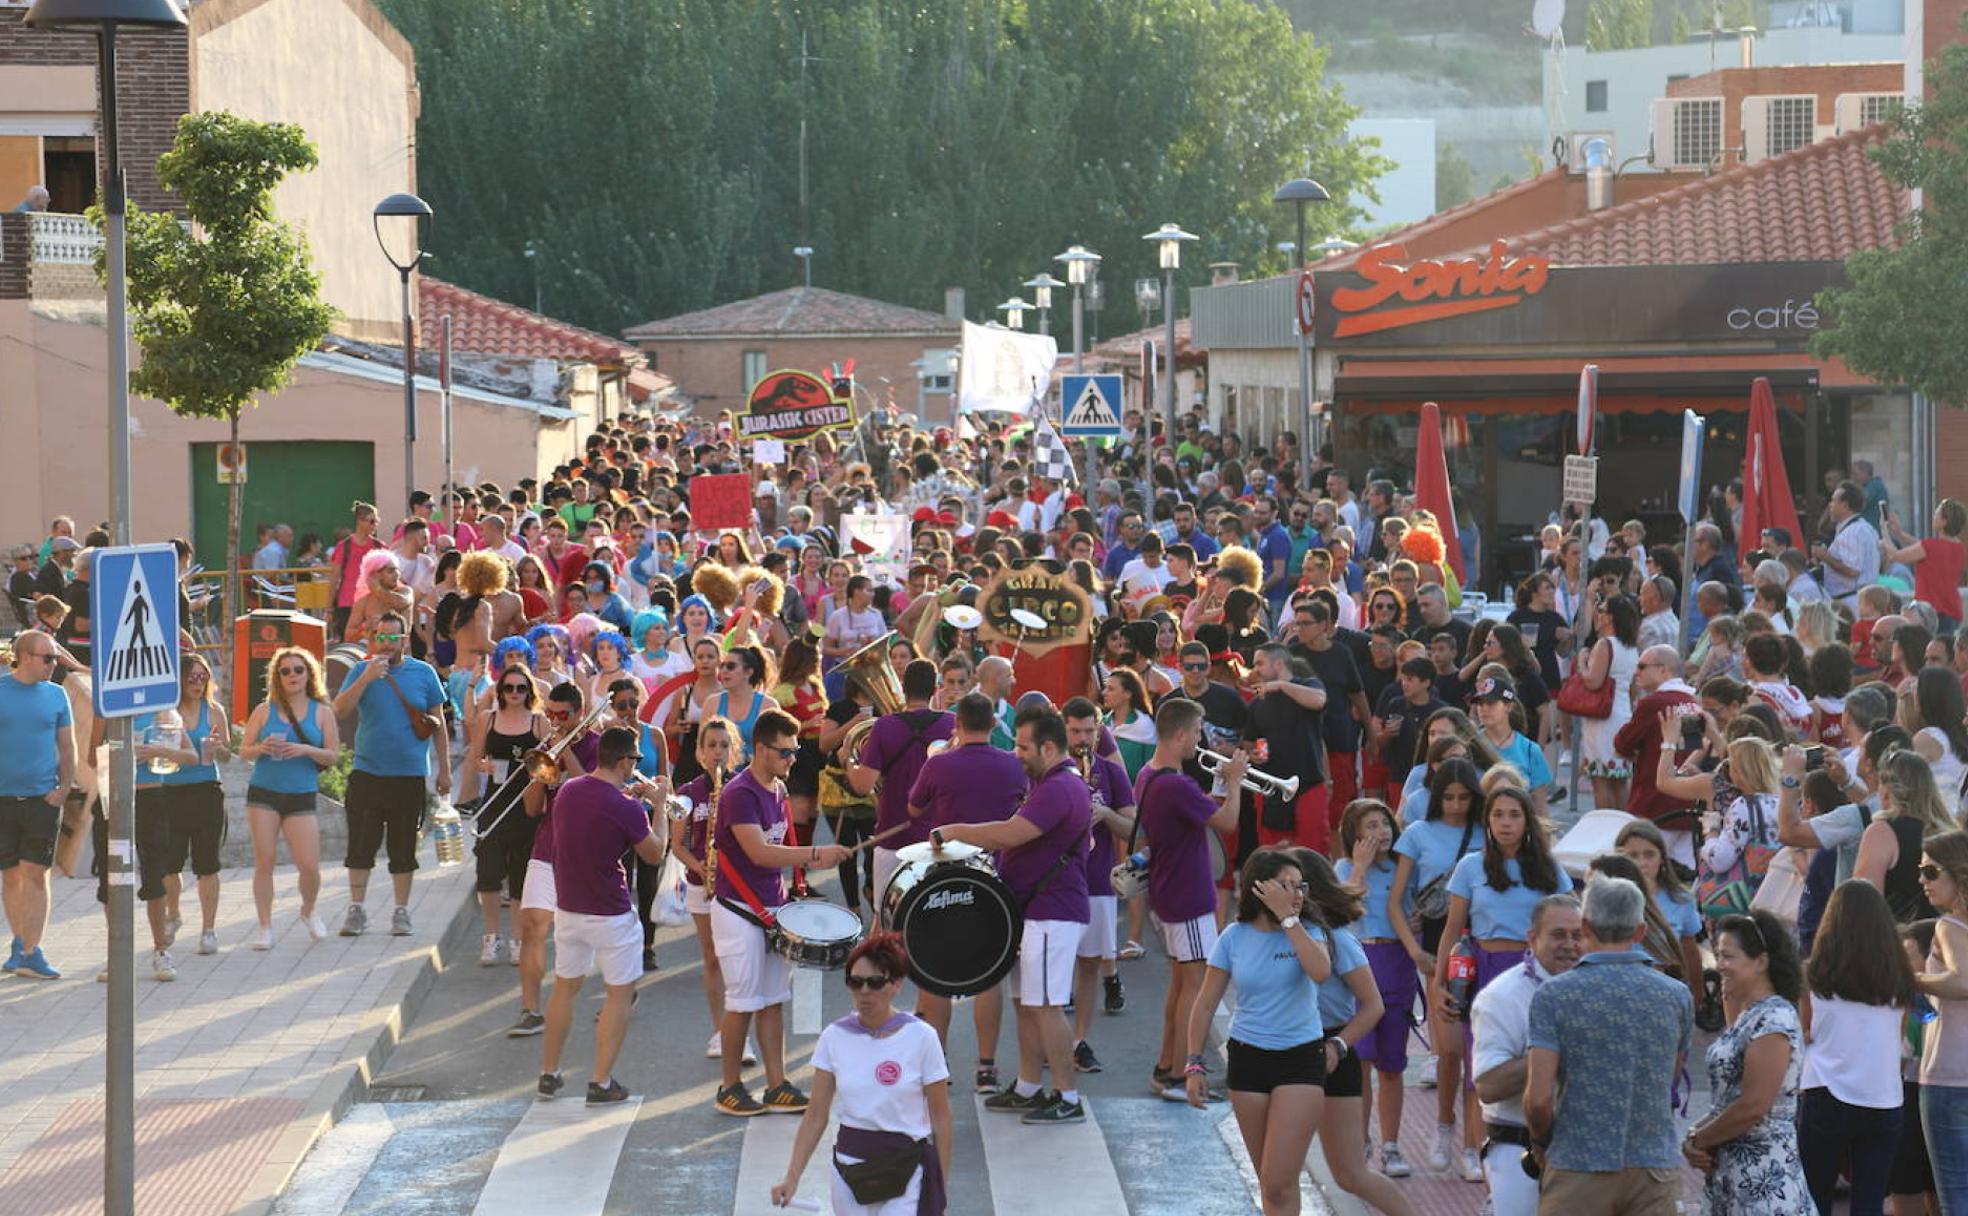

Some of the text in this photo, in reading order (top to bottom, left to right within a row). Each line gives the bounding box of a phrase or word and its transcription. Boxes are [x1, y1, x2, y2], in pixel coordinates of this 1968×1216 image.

[1332, 238, 1552, 313] Sonia
[1726, 300, 1820, 330] café
[740, 405, 849, 436] JURASSIC CISTER
[1006, 573, 1063, 590] GRAN
